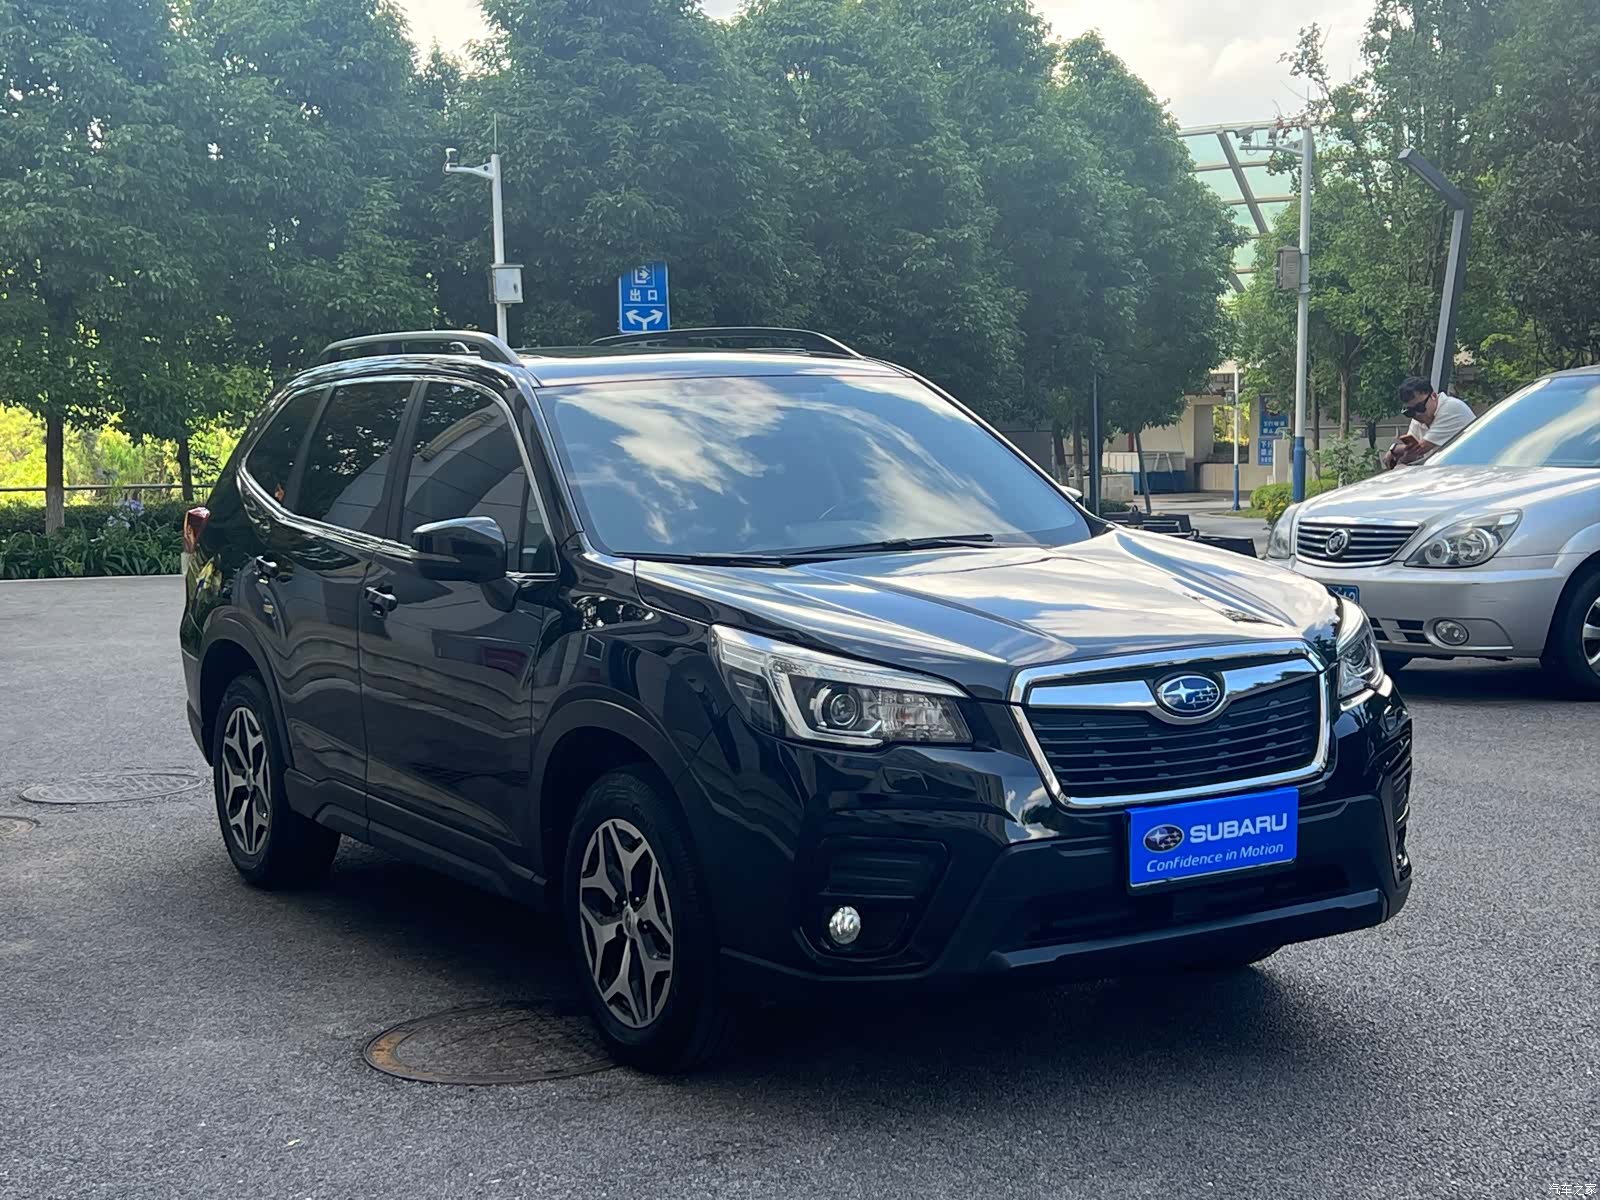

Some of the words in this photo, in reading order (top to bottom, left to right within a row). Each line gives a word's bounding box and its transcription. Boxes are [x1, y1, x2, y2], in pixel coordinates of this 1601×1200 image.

[630, 288, 658, 302] 出口
[1189, 812, 1288, 844] SUBARU
[1146, 852, 1223, 873] Confidence
[1225, 848, 1237, 861] in
[1239, 843, 1284, 859] Motion
